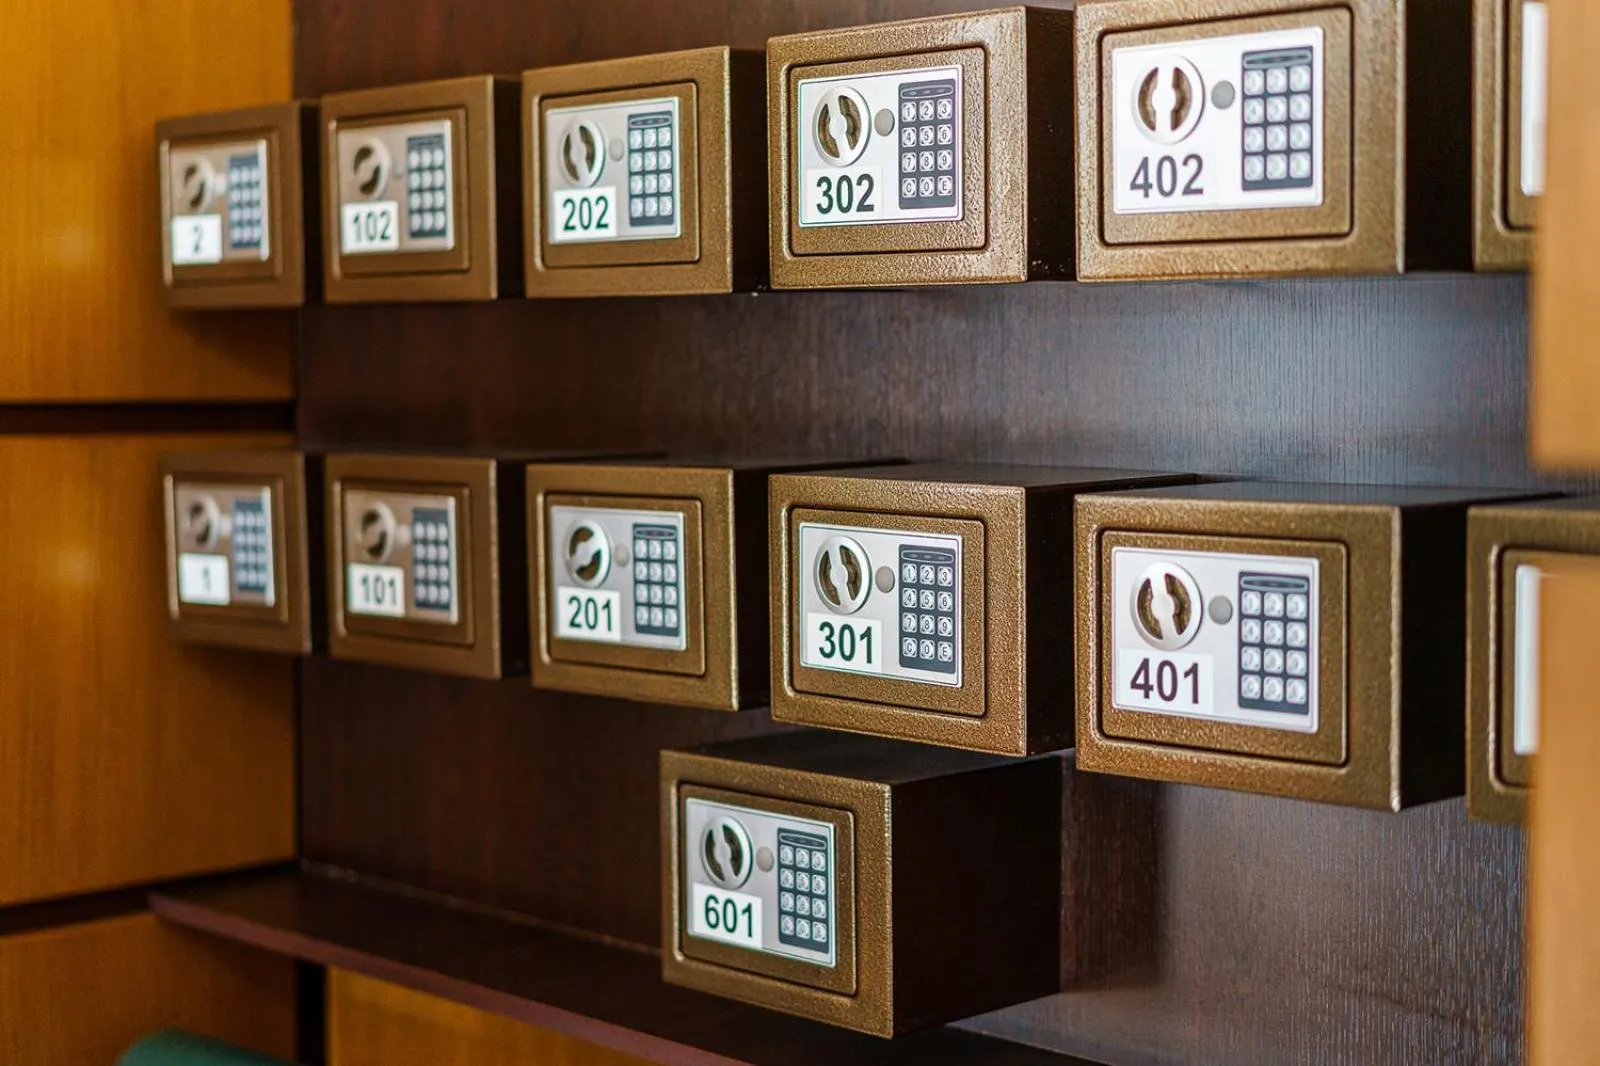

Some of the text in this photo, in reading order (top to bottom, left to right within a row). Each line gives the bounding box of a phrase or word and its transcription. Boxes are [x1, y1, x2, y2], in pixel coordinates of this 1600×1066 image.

[816, 173, 875, 215] 302
[1129, 153, 1204, 199] 402
[351, 209, 391, 243] 102
[562, 195, 609, 232] 202
[191, 224, 204, 257] 2
[201, 565, 212, 593] 1
[360, 573, 397, 606] 101
[568, 595, 612, 632] 201
[818, 621, 873, 665] 301
[1130, 657, 1199, 705] 401
[704, 894, 753, 938] 601
